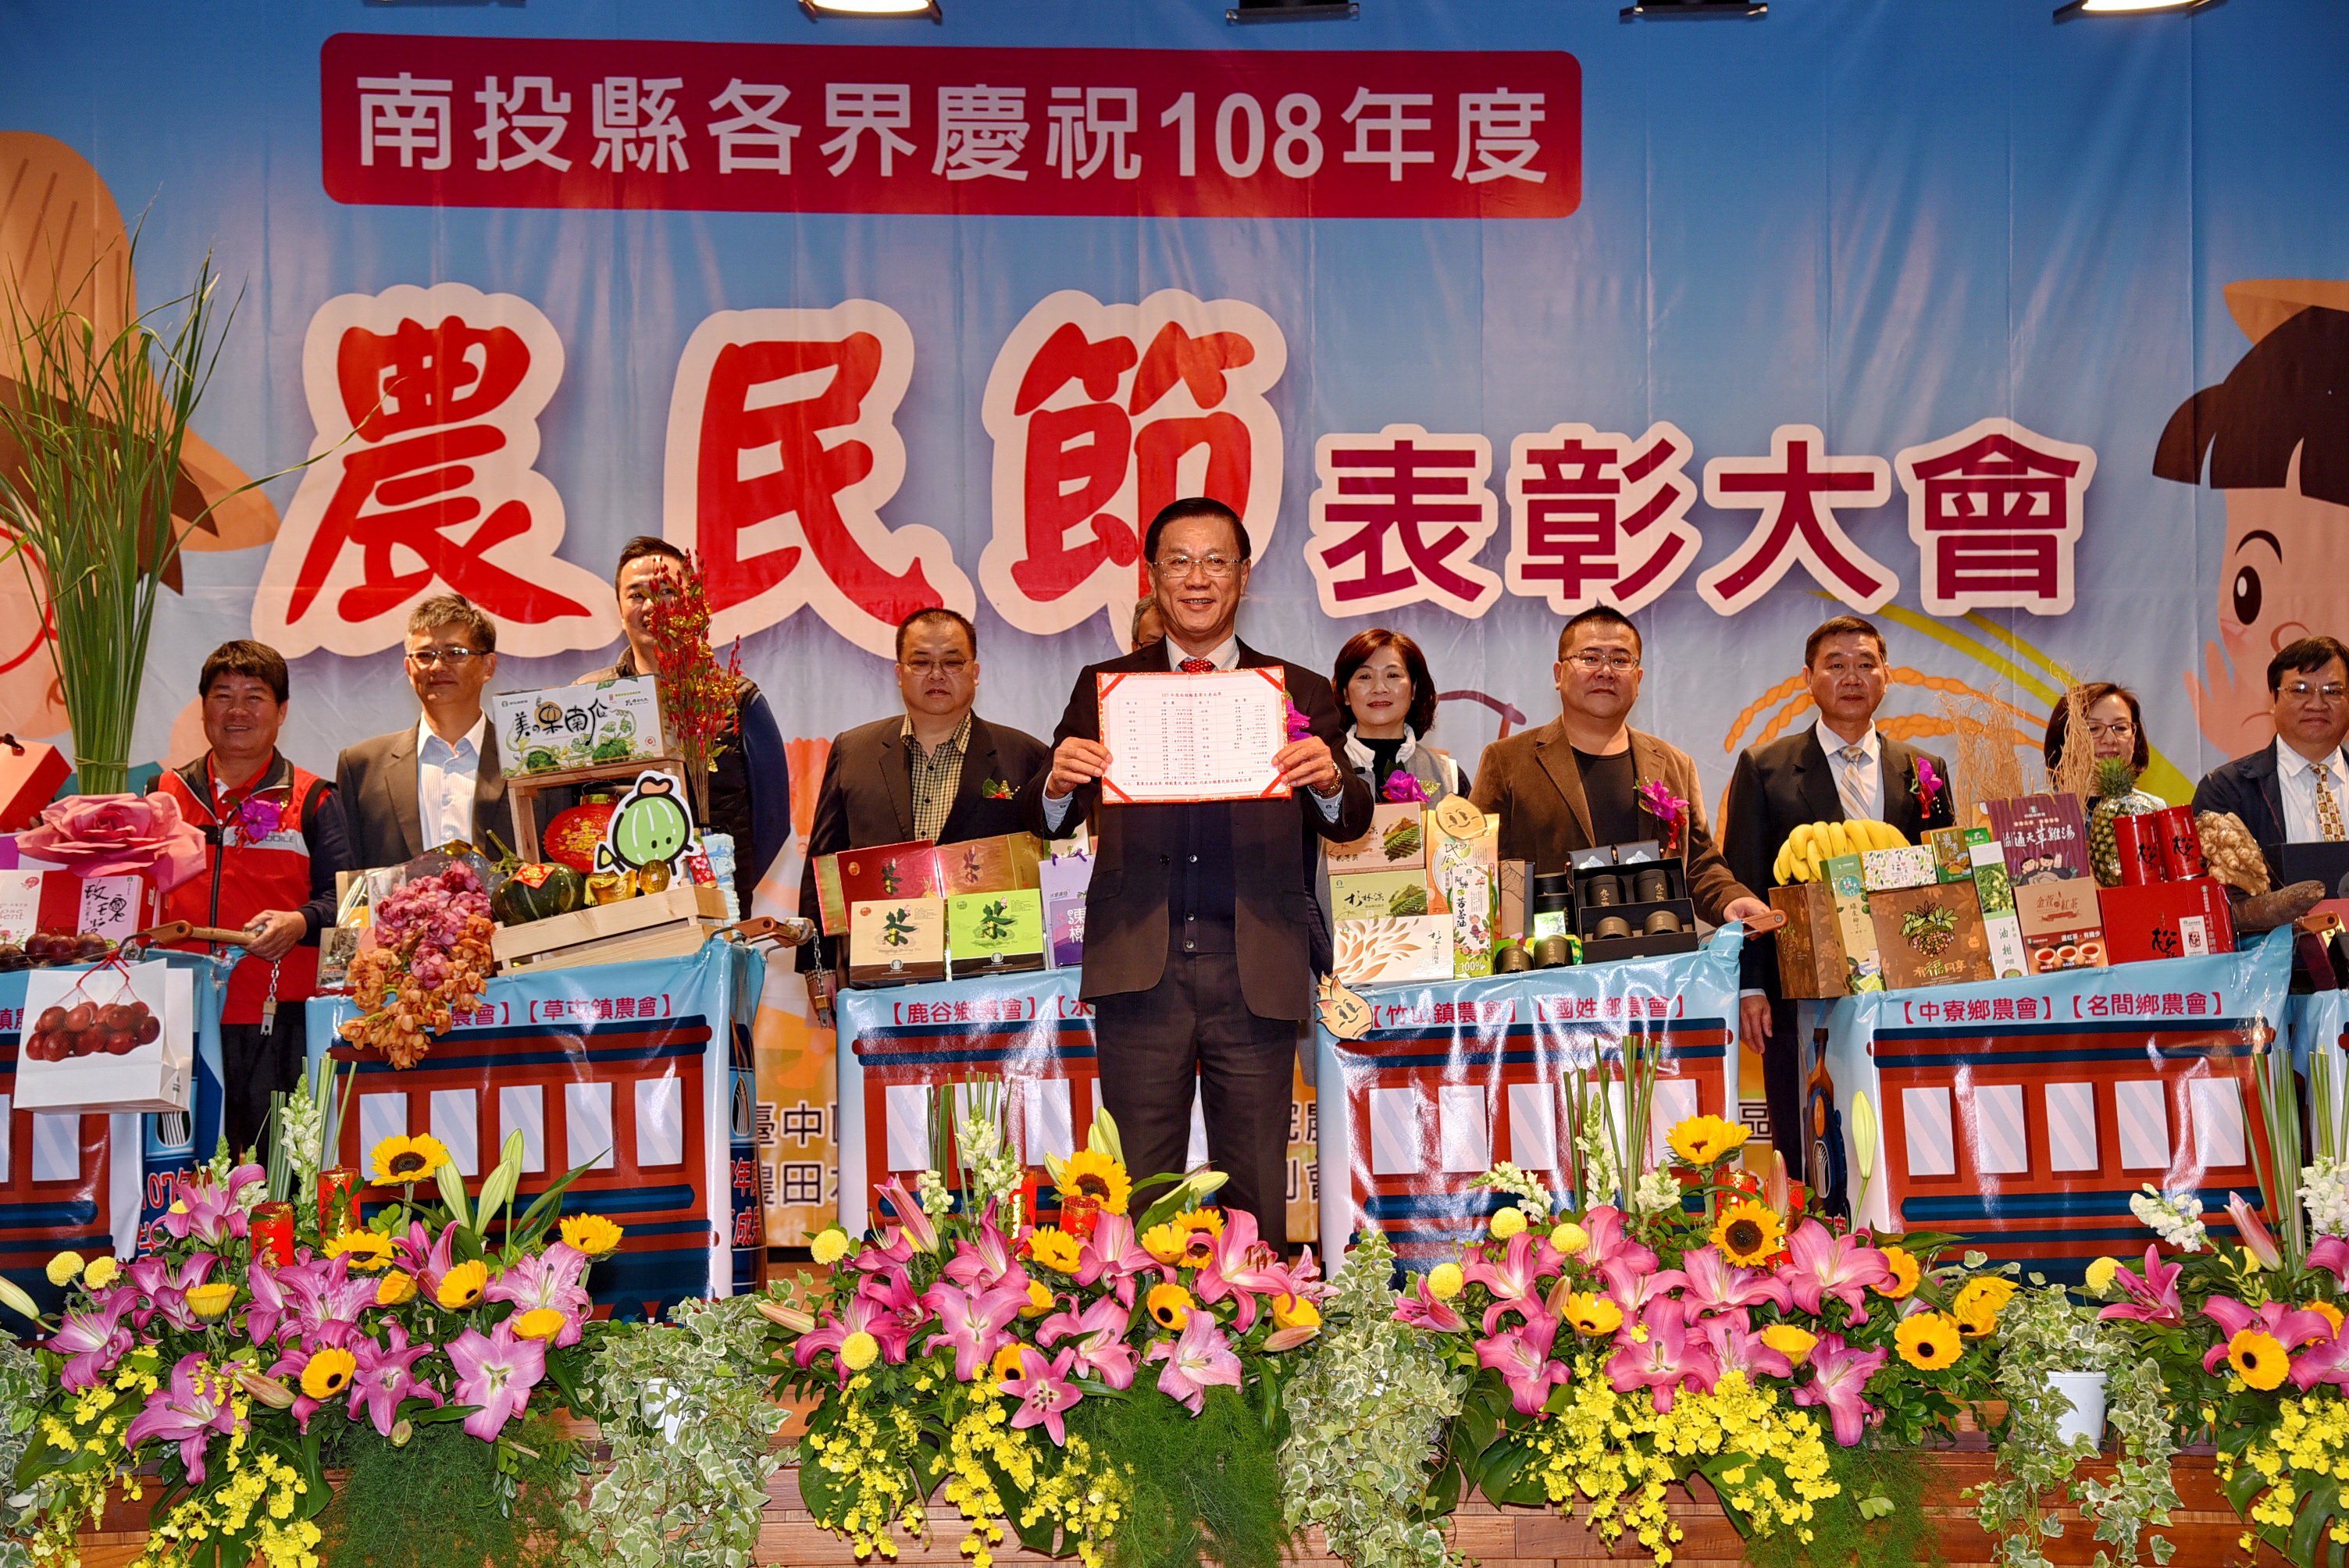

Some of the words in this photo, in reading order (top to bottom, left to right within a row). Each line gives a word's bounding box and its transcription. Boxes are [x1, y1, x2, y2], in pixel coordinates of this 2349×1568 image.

[356, 72, 1548, 184] 南投縣各界慶祝108年度
[285, 314, 1256, 625] 農民節
[1319, 433, 2081, 602] 表彰大會
